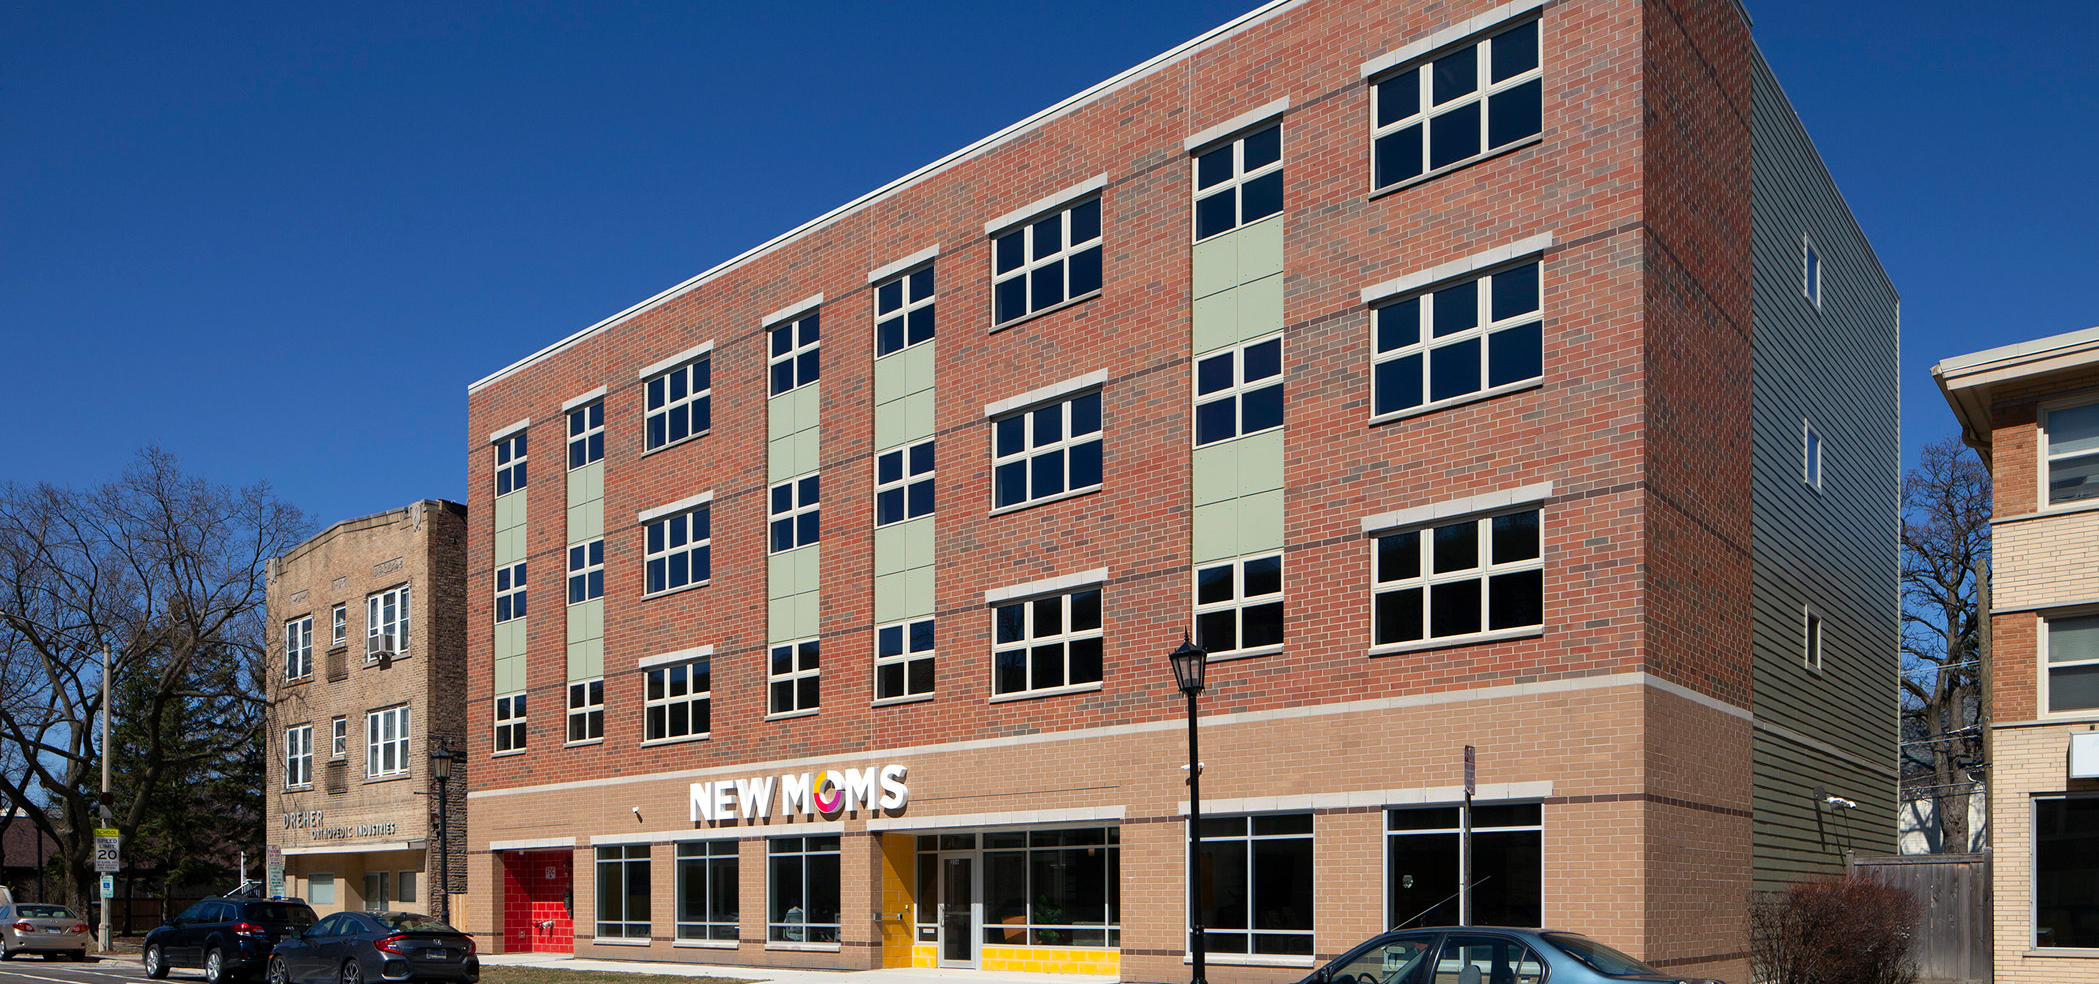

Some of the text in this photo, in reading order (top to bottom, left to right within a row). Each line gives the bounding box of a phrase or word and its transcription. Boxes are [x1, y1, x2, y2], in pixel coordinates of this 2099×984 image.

[690, 764, 909, 822] NEW MOMS
[283, 810, 324, 830] DREHER
[312, 822, 396, 840] ORTHOPEDIC INDUSTRIES
[97, 850, 117, 860] 20
